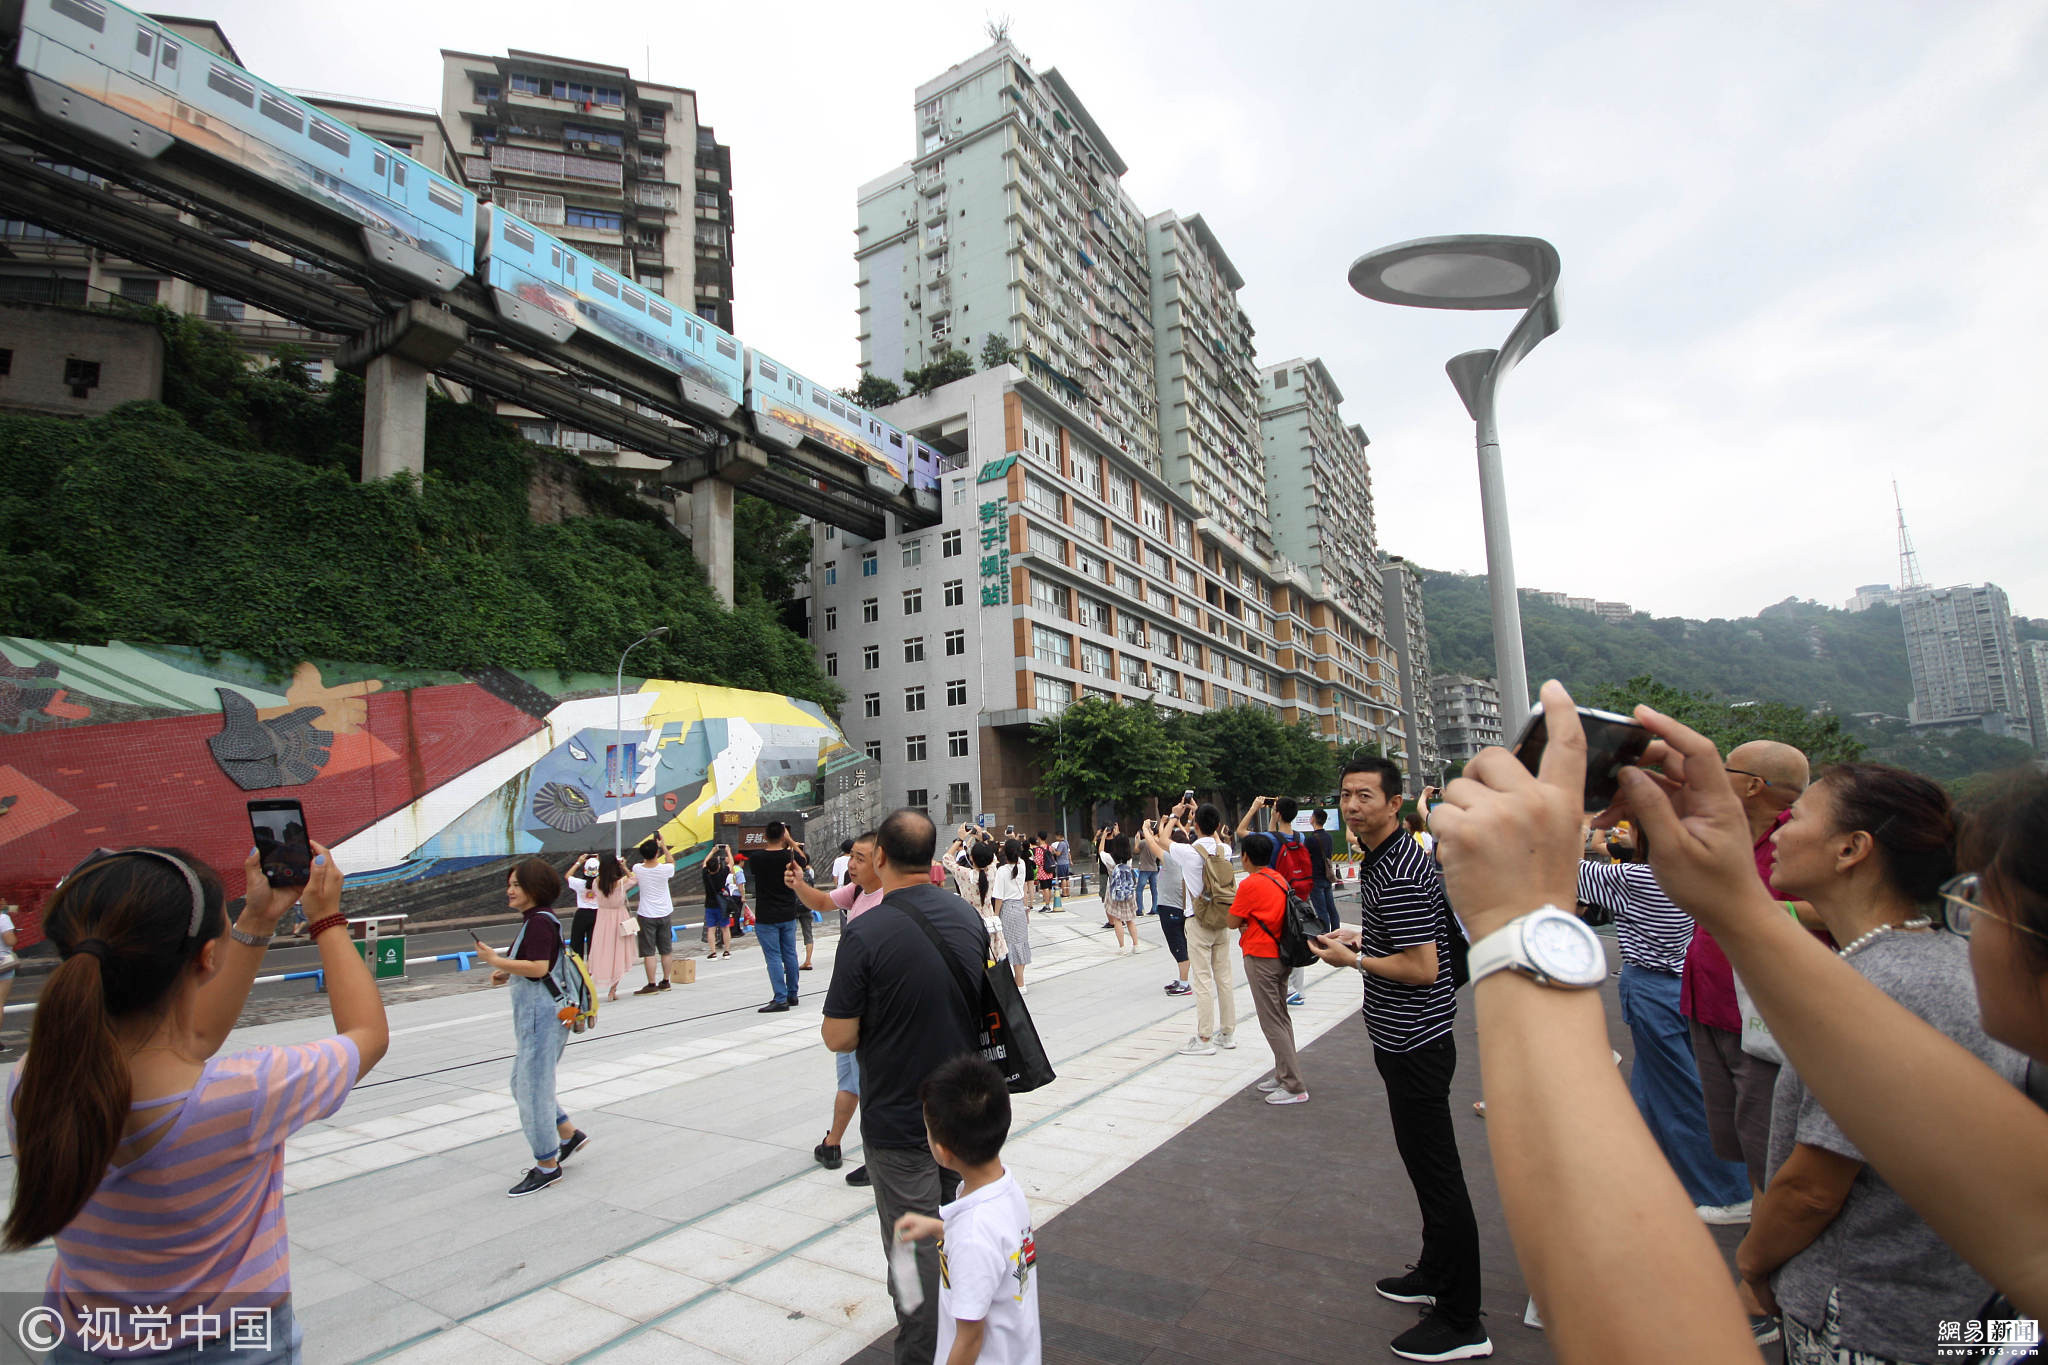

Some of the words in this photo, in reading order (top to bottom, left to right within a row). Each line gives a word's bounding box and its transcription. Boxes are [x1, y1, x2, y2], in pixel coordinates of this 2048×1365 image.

[998, 497, 1008, 543] Liziba
[979, 501, 1000, 607] 李子坝站
[999, 548, 1010, 605] Station
